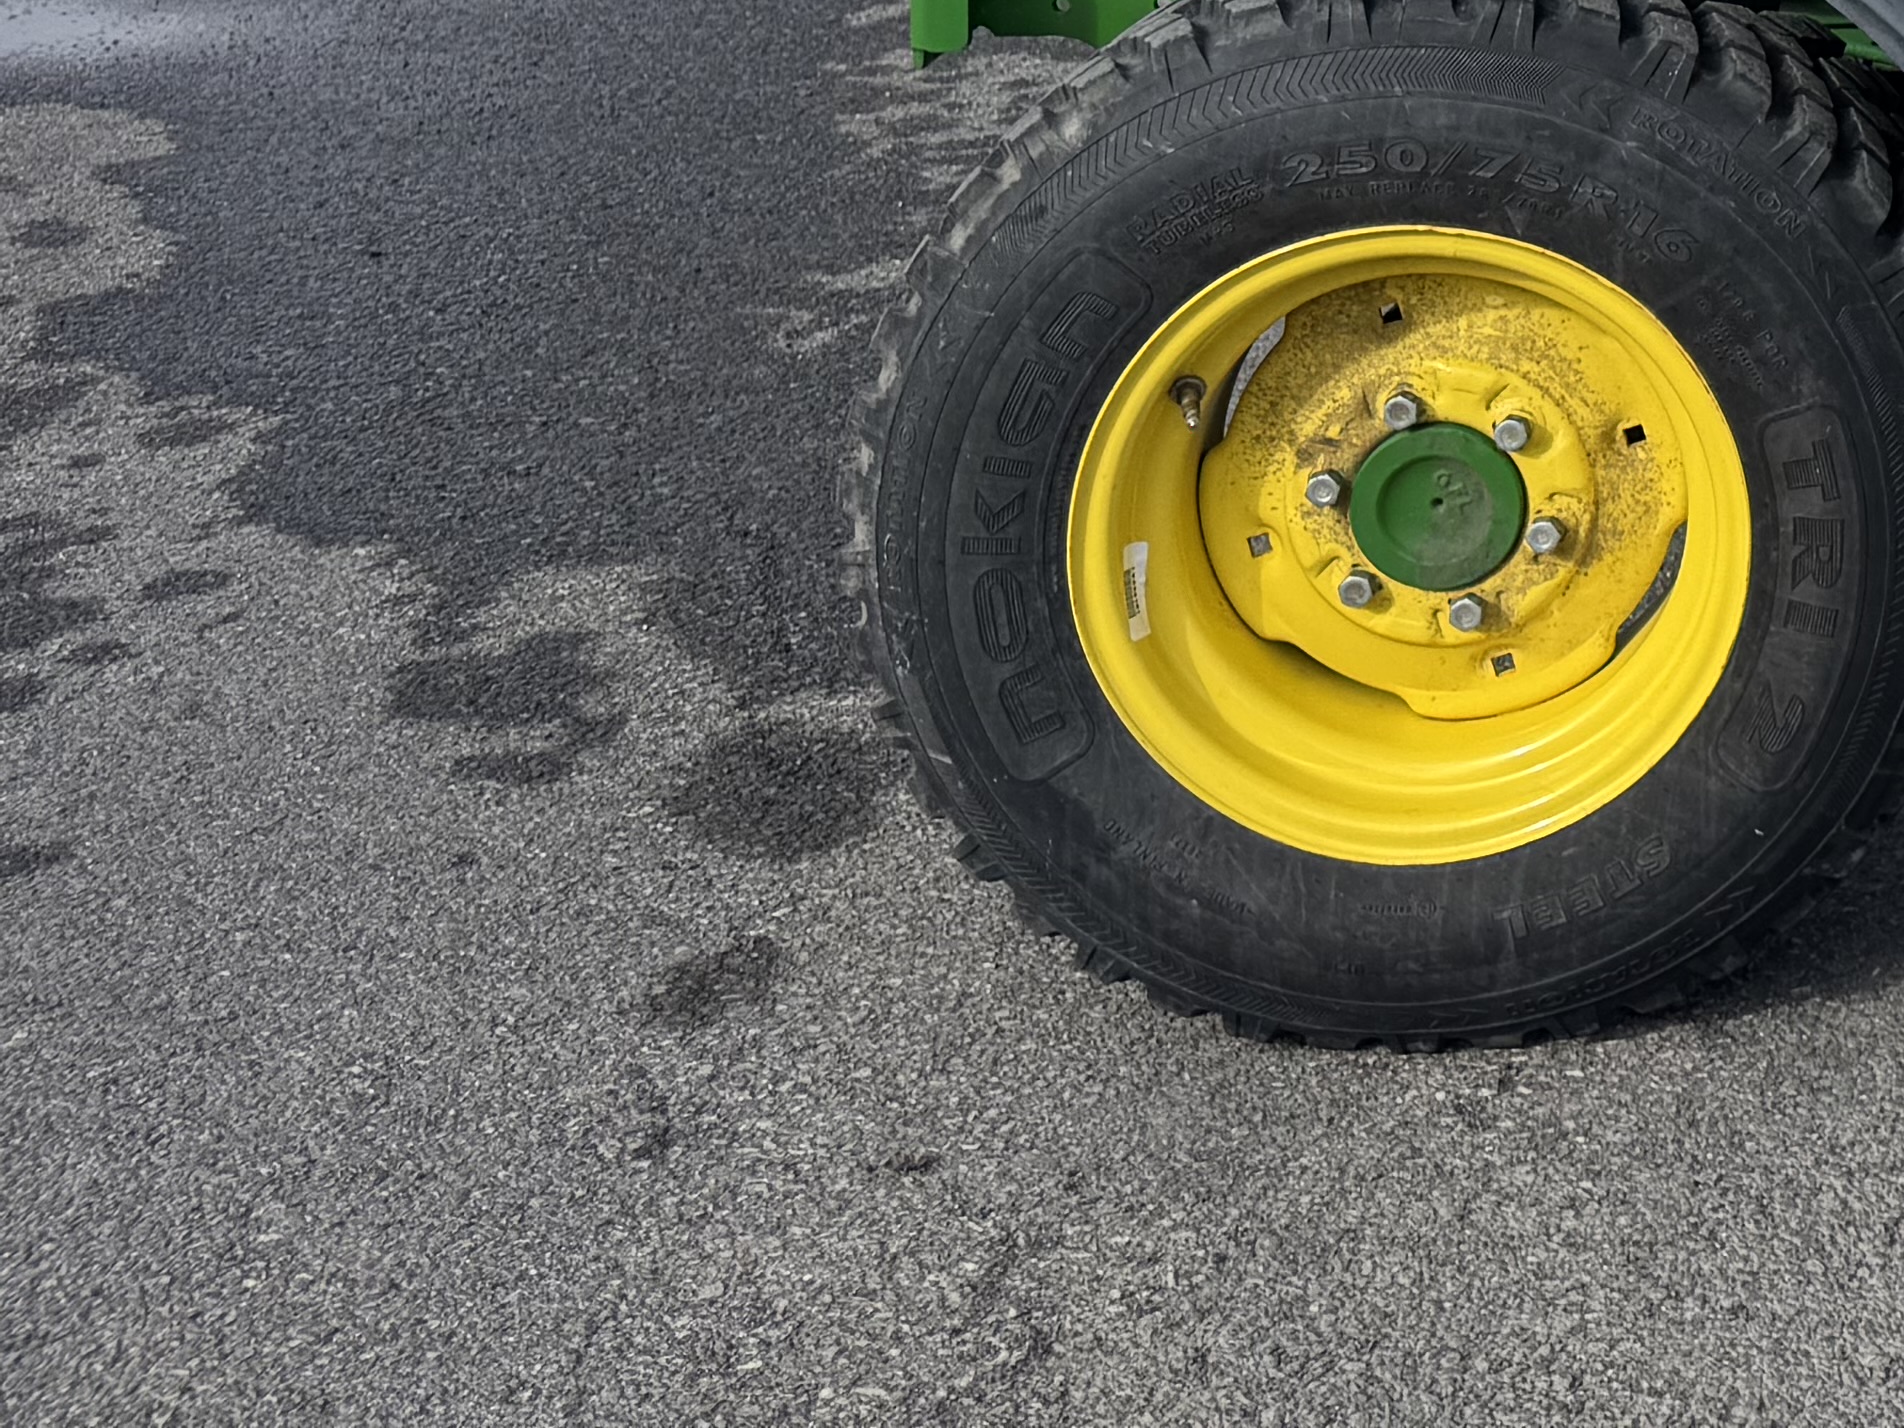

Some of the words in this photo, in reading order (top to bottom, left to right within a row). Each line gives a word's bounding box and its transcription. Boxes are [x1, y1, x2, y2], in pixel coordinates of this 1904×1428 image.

[1780, 437, 1847, 639] TRI
[1743, 682, 1808, 757] 2
[1489, 832, 1677, 944] STEEL
